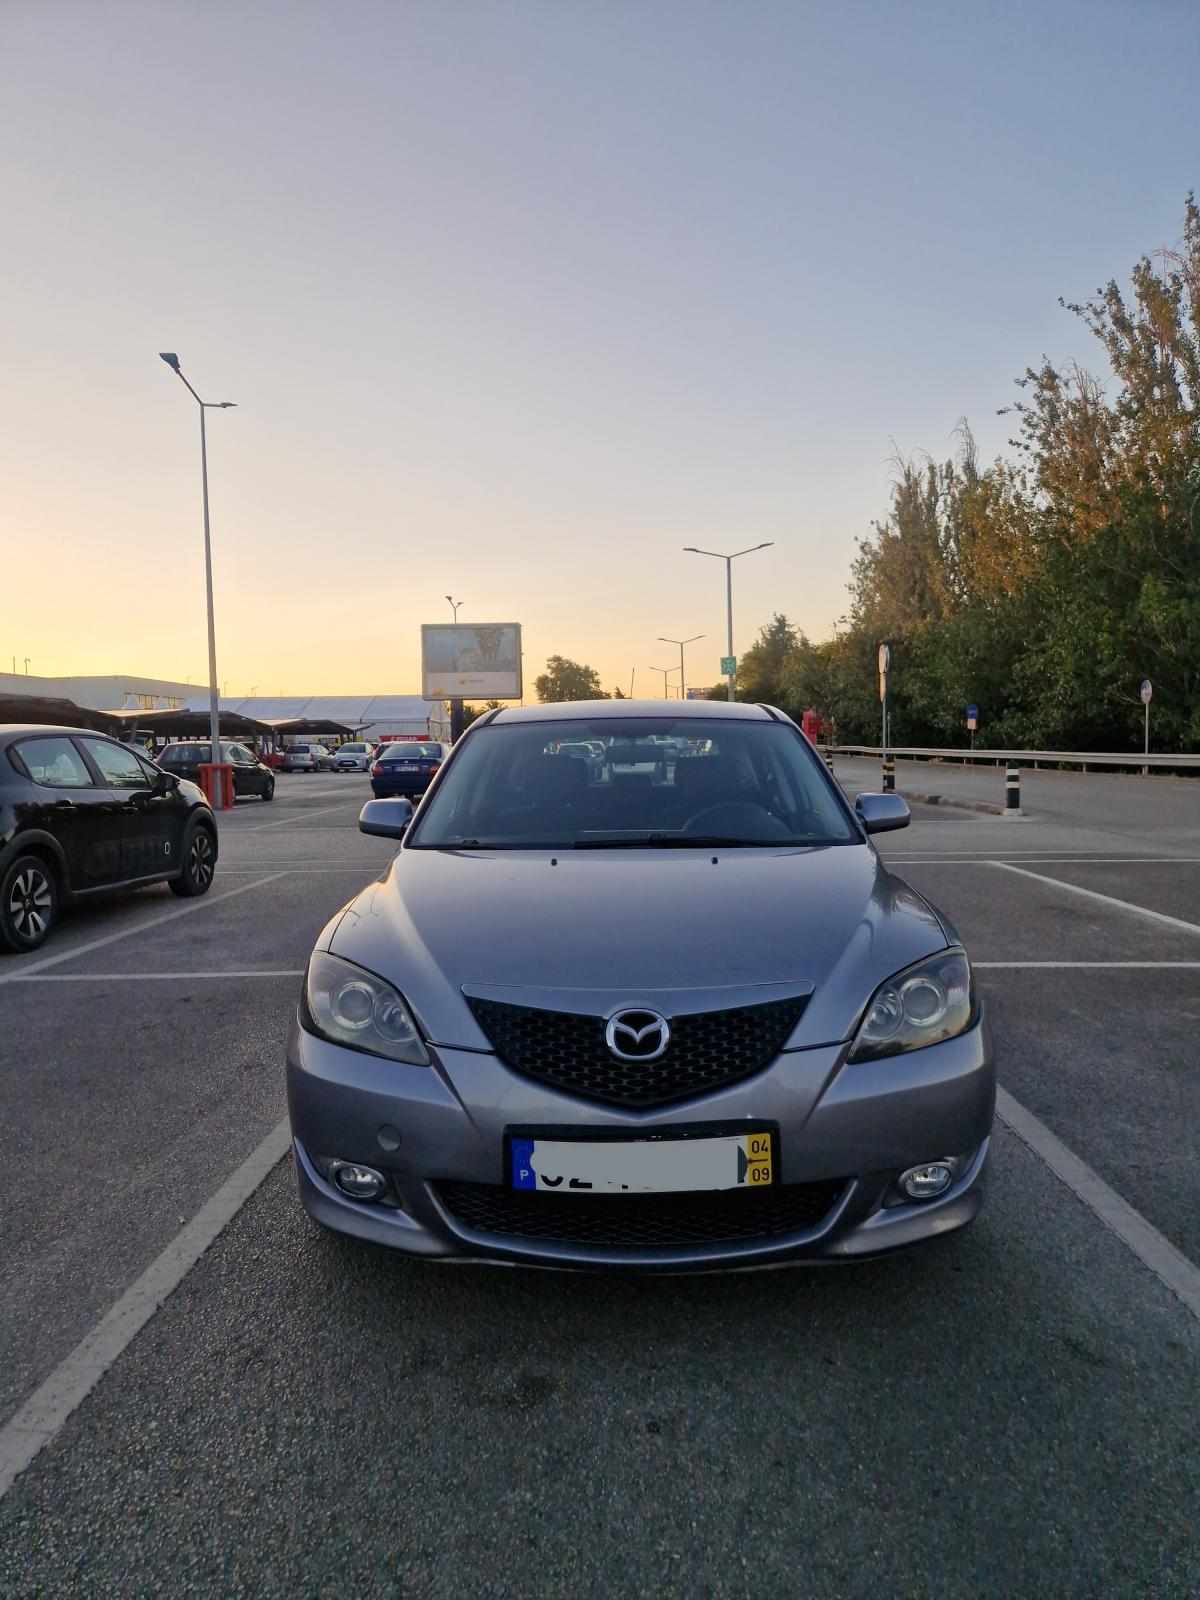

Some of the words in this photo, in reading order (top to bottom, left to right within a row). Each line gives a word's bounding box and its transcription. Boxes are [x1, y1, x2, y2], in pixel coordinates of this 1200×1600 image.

[752, 1140, 768, 1153] 04
[520, 1169, 528, 1180] P
[752, 1168, 769, 1181] 09
